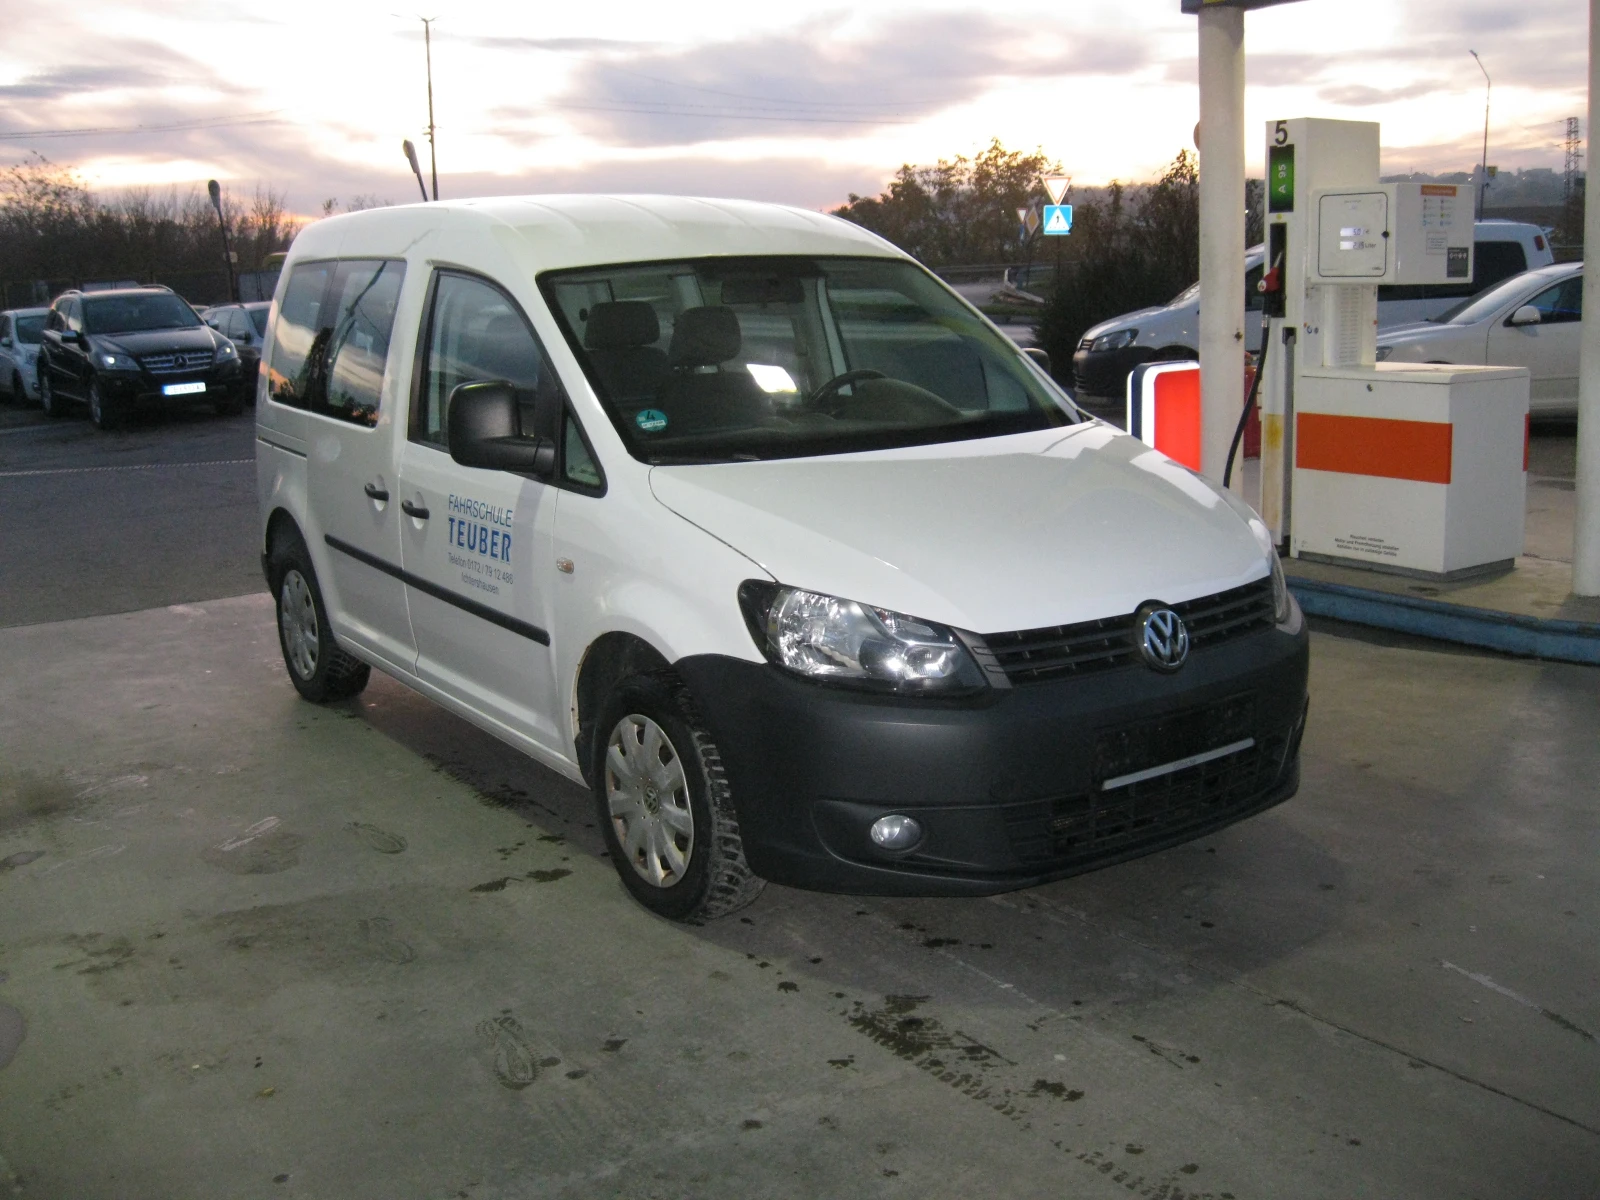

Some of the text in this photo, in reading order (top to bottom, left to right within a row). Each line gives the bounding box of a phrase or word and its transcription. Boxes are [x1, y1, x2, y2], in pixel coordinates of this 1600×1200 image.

[1275, 119, 1288, 145] 5
[1278, 163, 1287, 179] 95
[448, 494, 513, 528] FAHRSCHULE
[448, 516, 512, 563] TEUBER
